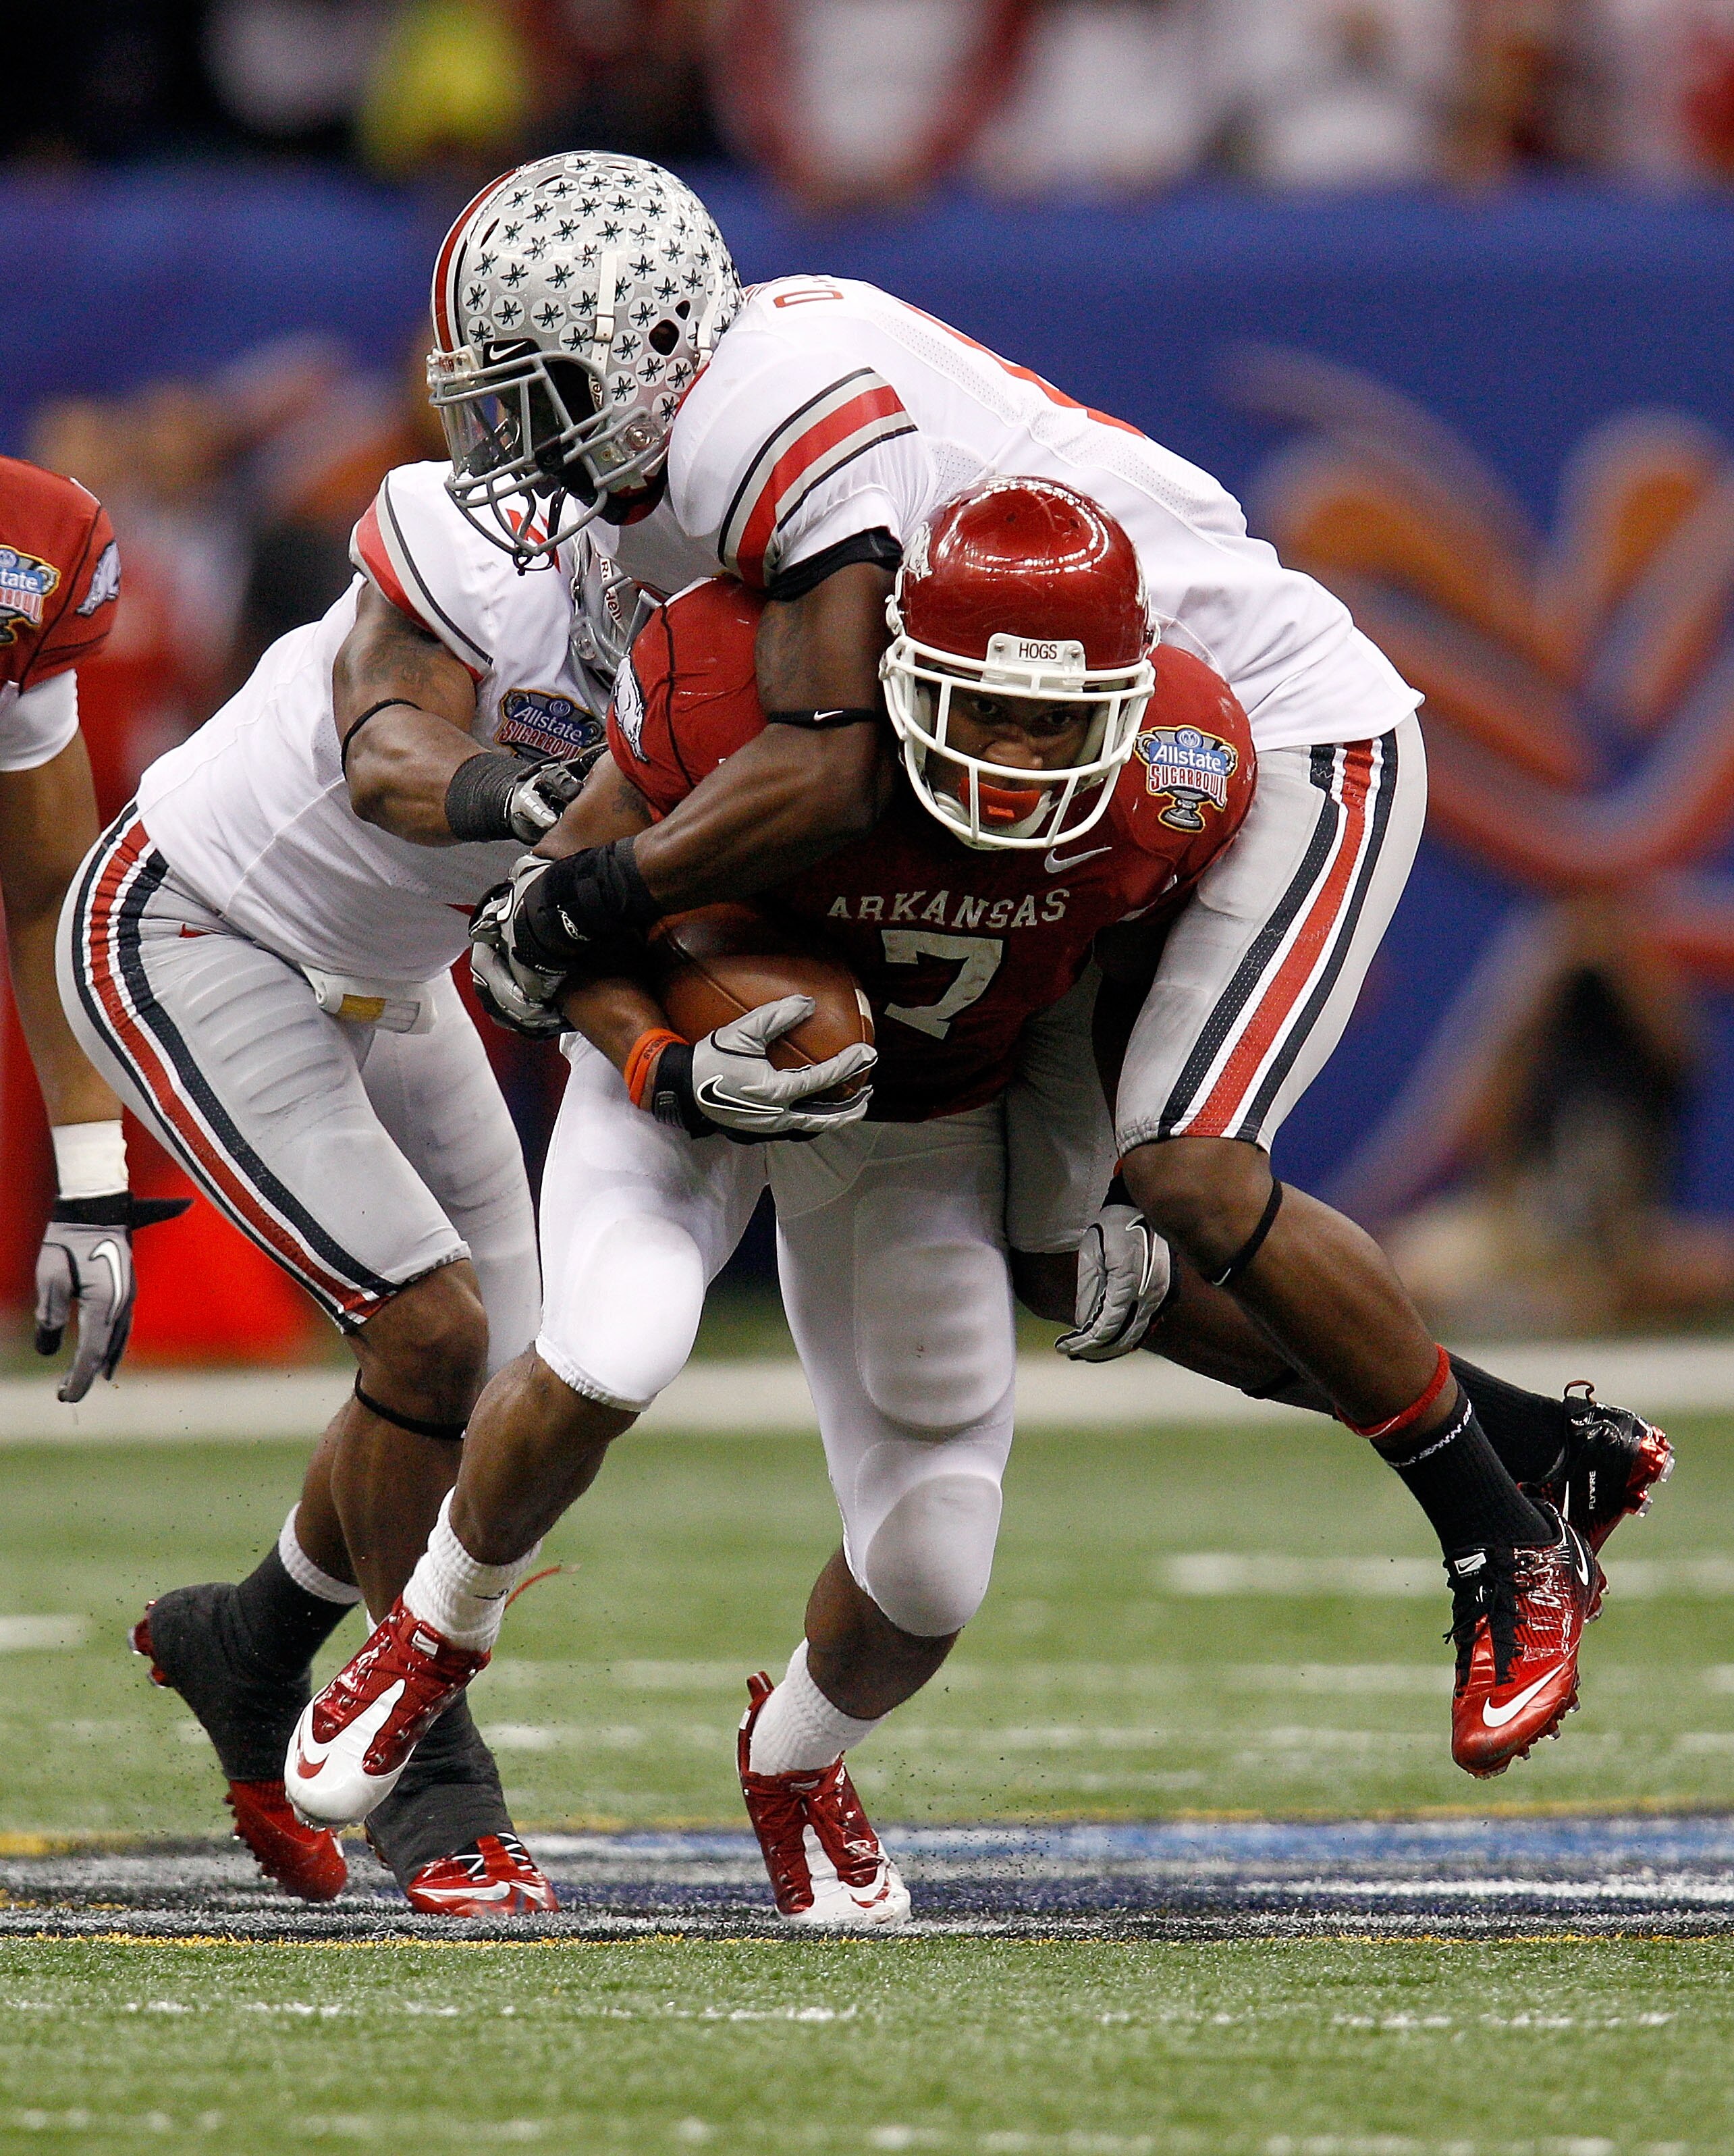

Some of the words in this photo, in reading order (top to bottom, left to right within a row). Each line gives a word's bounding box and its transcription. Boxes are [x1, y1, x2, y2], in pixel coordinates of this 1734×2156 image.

[1019, 643, 1057, 659] HOGS
[514, 706, 582, 741] Allstate
[1153, 745, 1221, 772] Allstate
[827, 888, 1070, 929] ARKANSAS
[881, 929, 1004, 1040] 7
